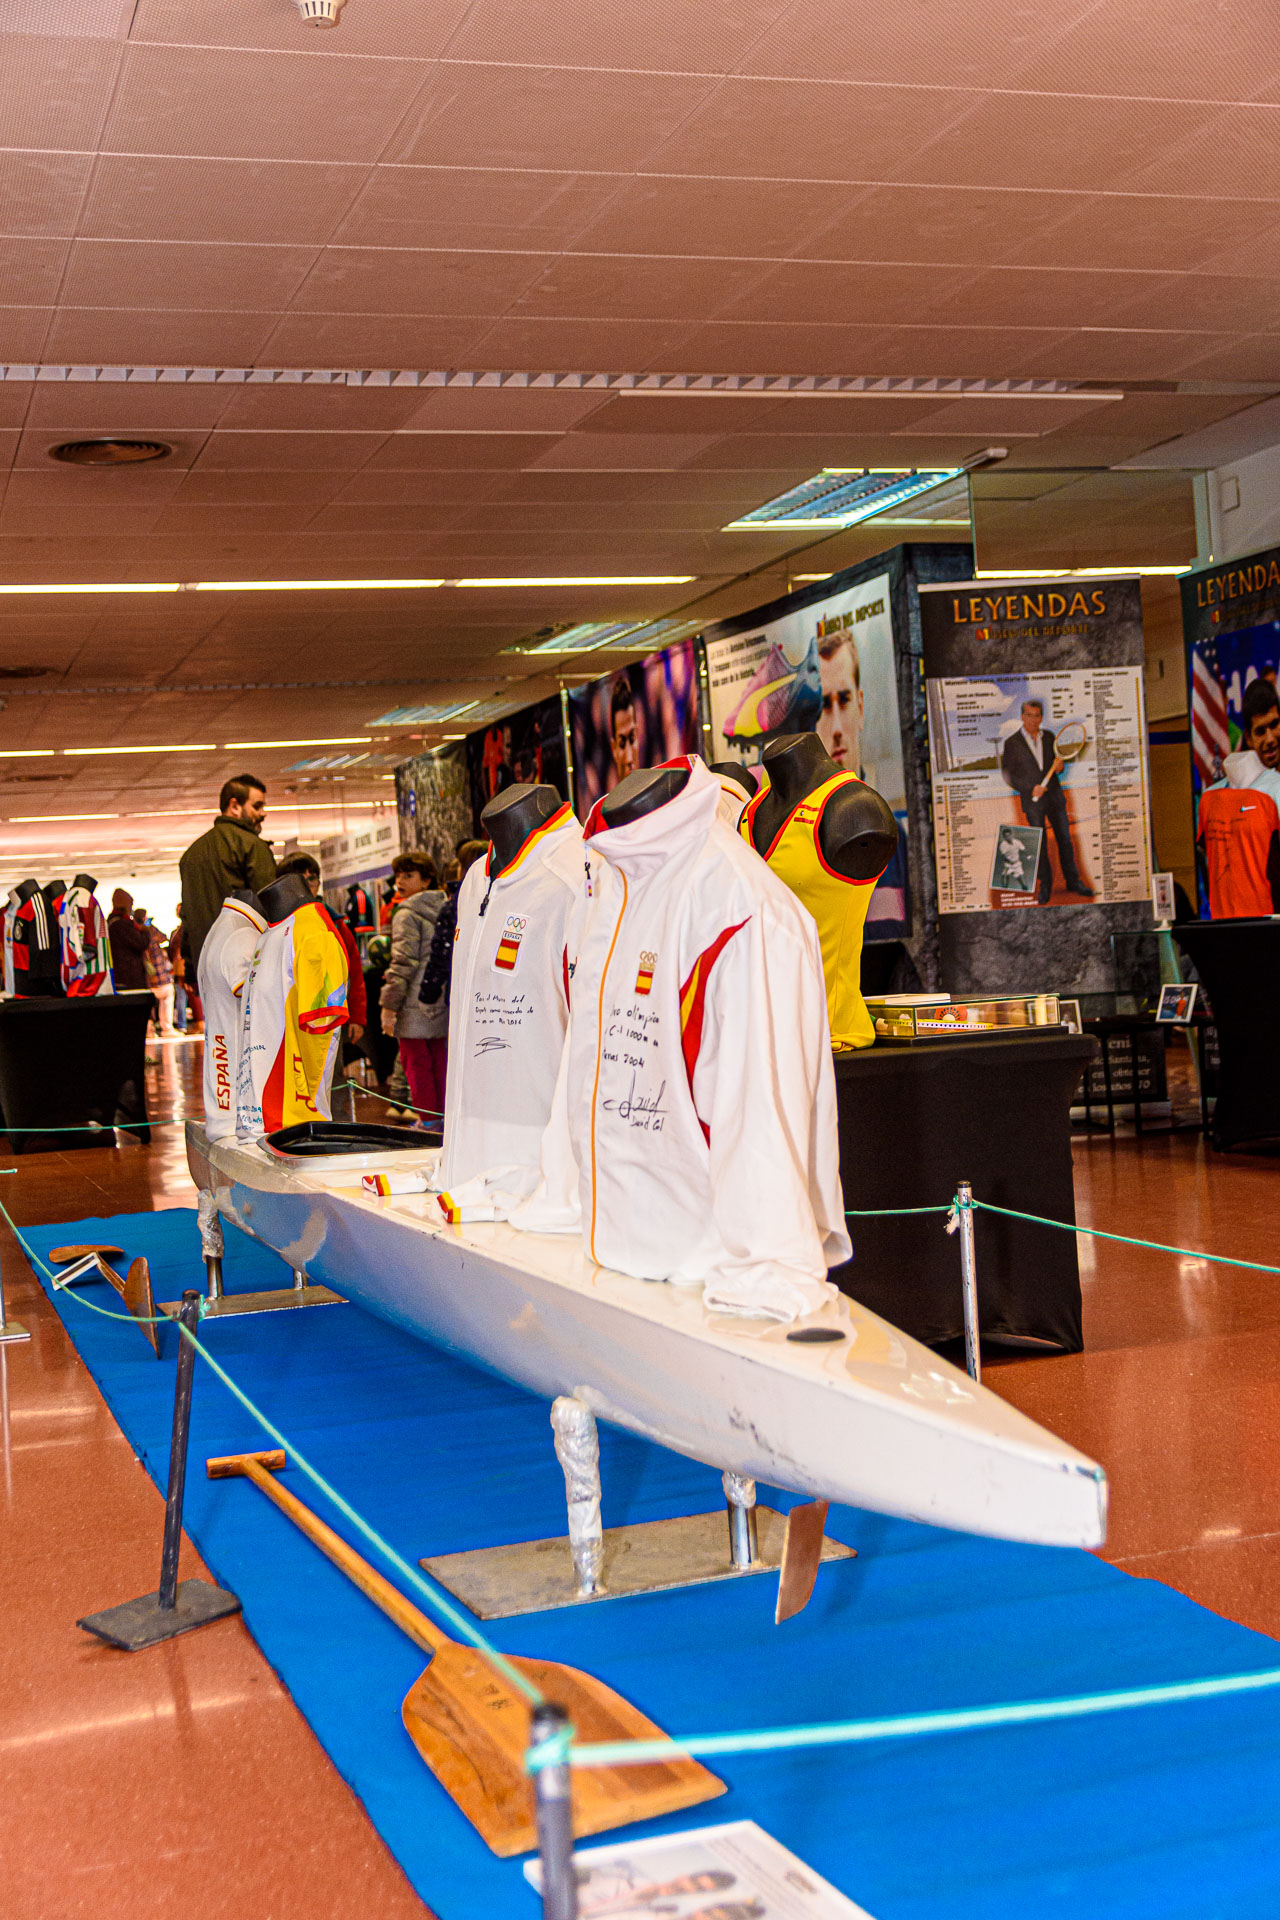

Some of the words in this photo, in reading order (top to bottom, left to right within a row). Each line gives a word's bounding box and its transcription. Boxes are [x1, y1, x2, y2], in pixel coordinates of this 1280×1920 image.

[1197, 560, 1280, 608] LEYENDA
[953, 590, 1107, 623] LEYENDAS
[214, 1034, 230, 1111] ESPAÑA
[624, 1053, 645, 1068] 2004
